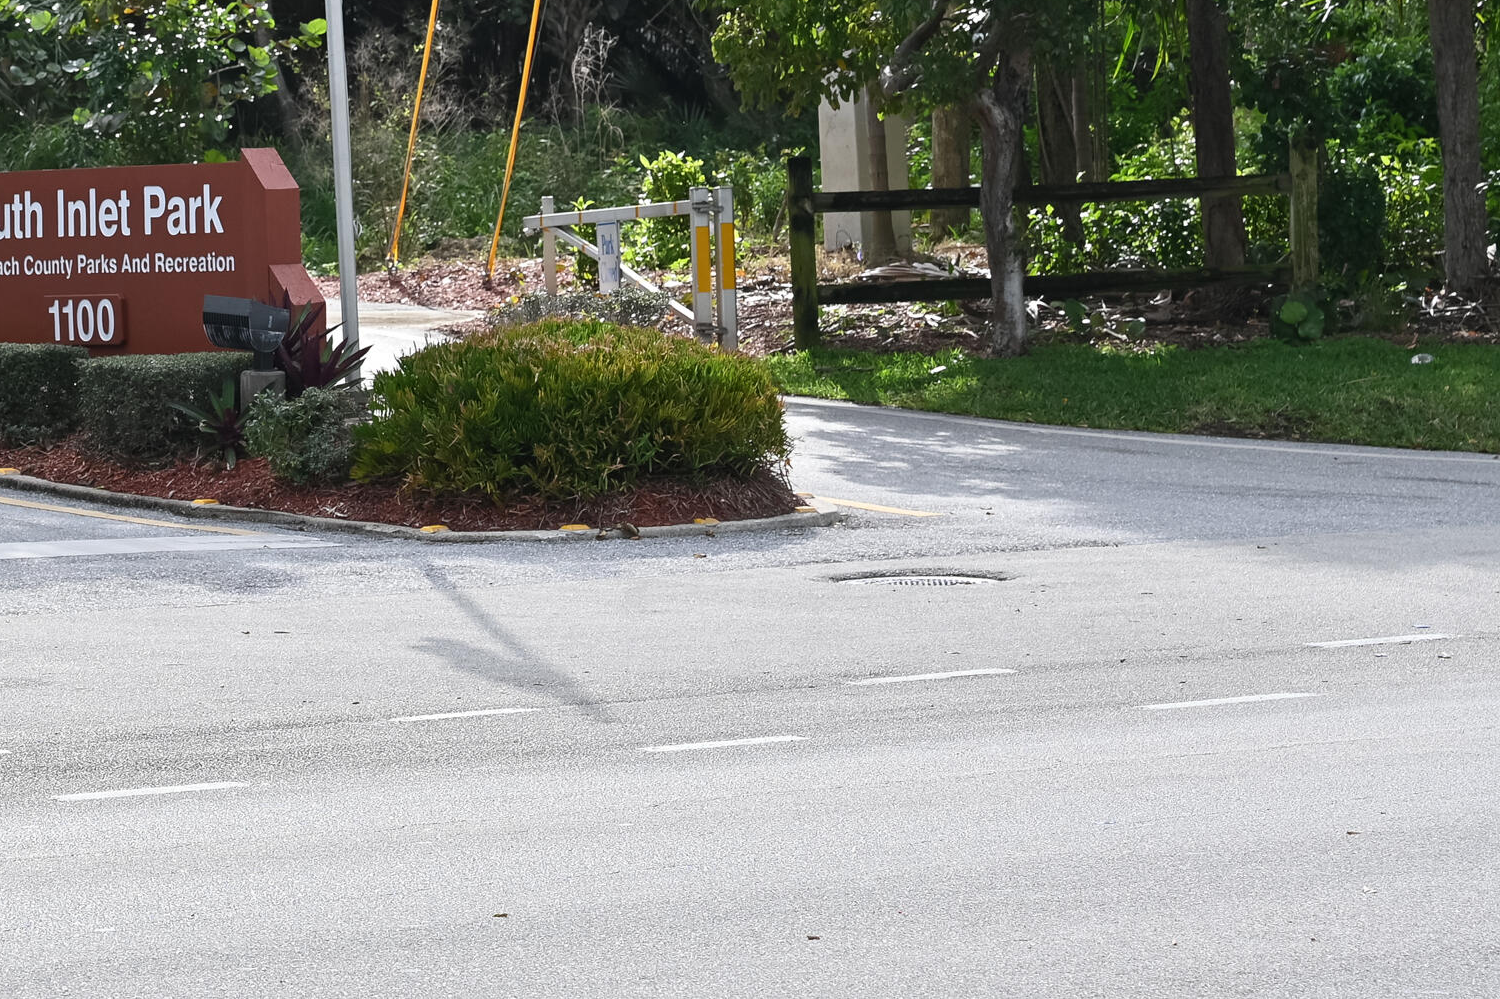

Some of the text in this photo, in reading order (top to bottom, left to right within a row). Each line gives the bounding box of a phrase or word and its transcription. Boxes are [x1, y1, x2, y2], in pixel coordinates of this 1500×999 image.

[57, 188, 131, 237] Inlet
[143, 183, 225, 236] Park
[23, 255, 73, 280] County
[77, 254, 117, 274] Parks
[121, 253, 150, 274] And
[155, 251, 235, 272] Recreation
[48, 299, 115, 342] 1100
